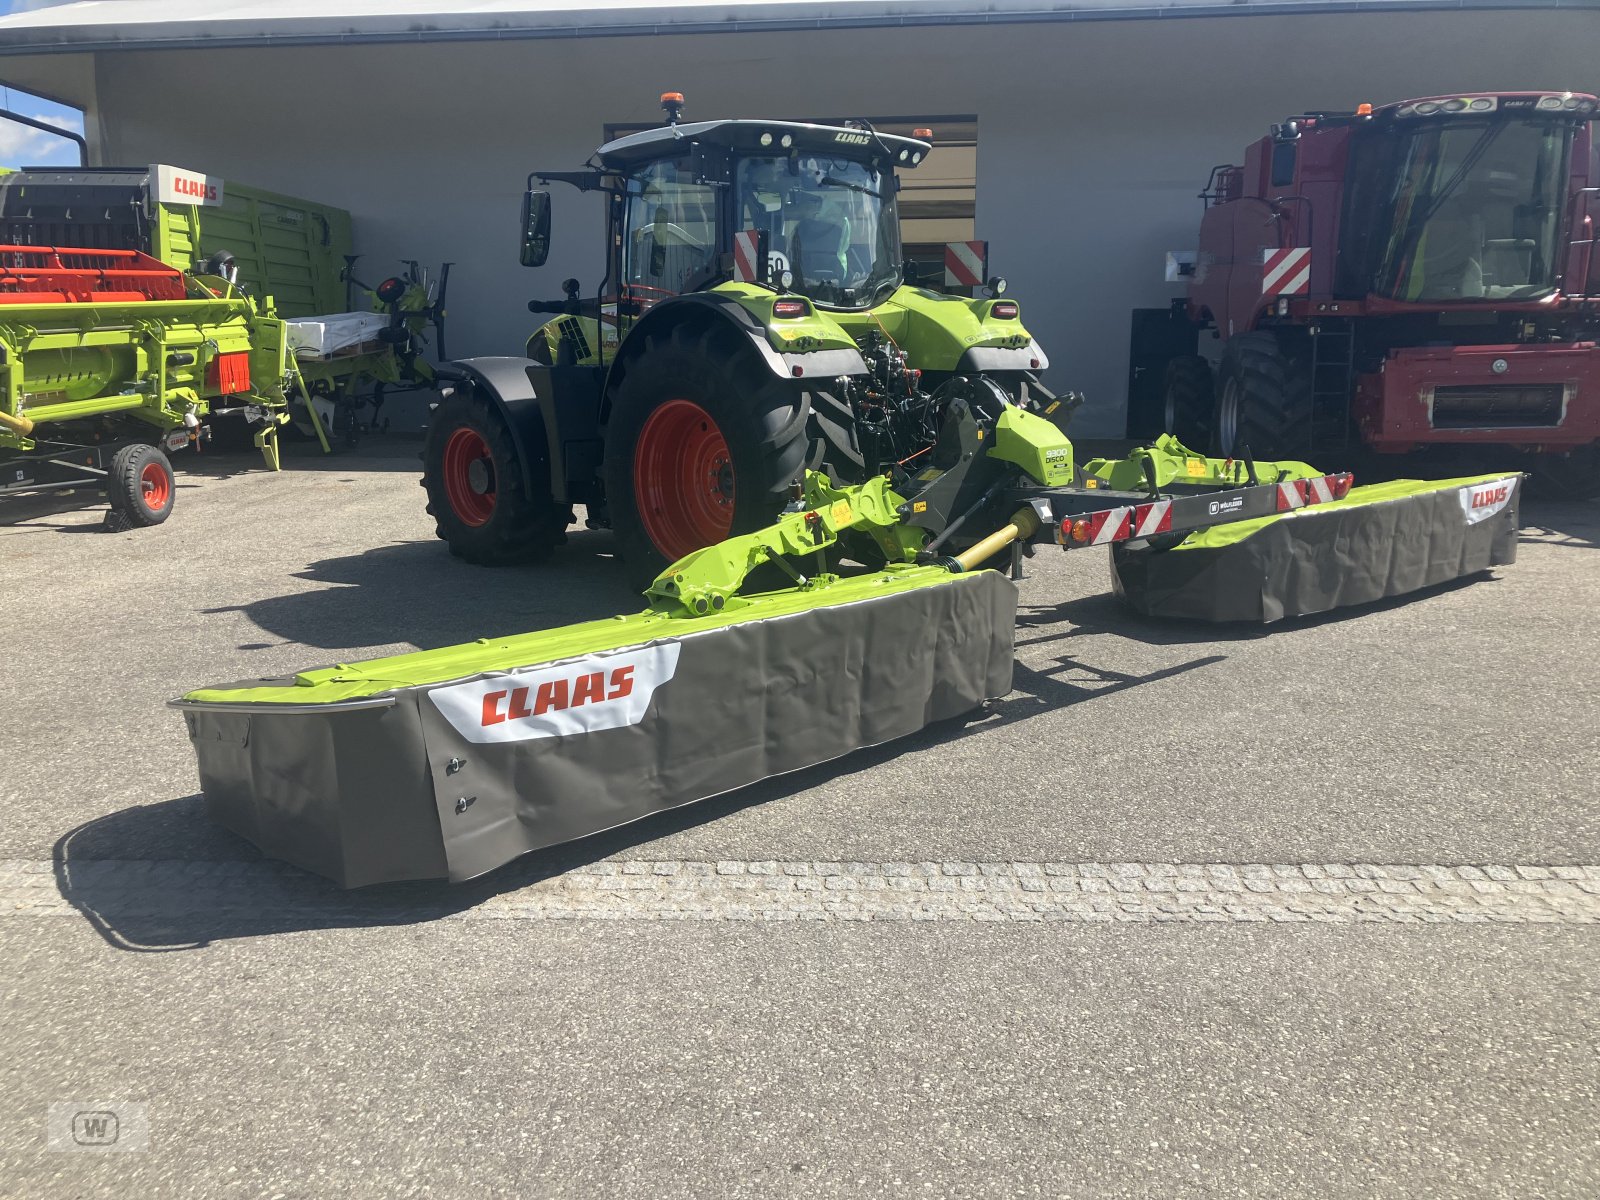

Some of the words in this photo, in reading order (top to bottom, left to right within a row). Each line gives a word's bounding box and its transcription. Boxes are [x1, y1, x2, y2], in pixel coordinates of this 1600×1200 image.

[835, 132, 870, 145] CLAAS
[174, 177, 217, 201] CLAAS
[1045, 455, 1065, 464] DISCO
[1046, 448, 1068, 458] 9300
[1471, 486, 1508, 509] CLAAS
[481, 664, 635, 727] CLAAS
